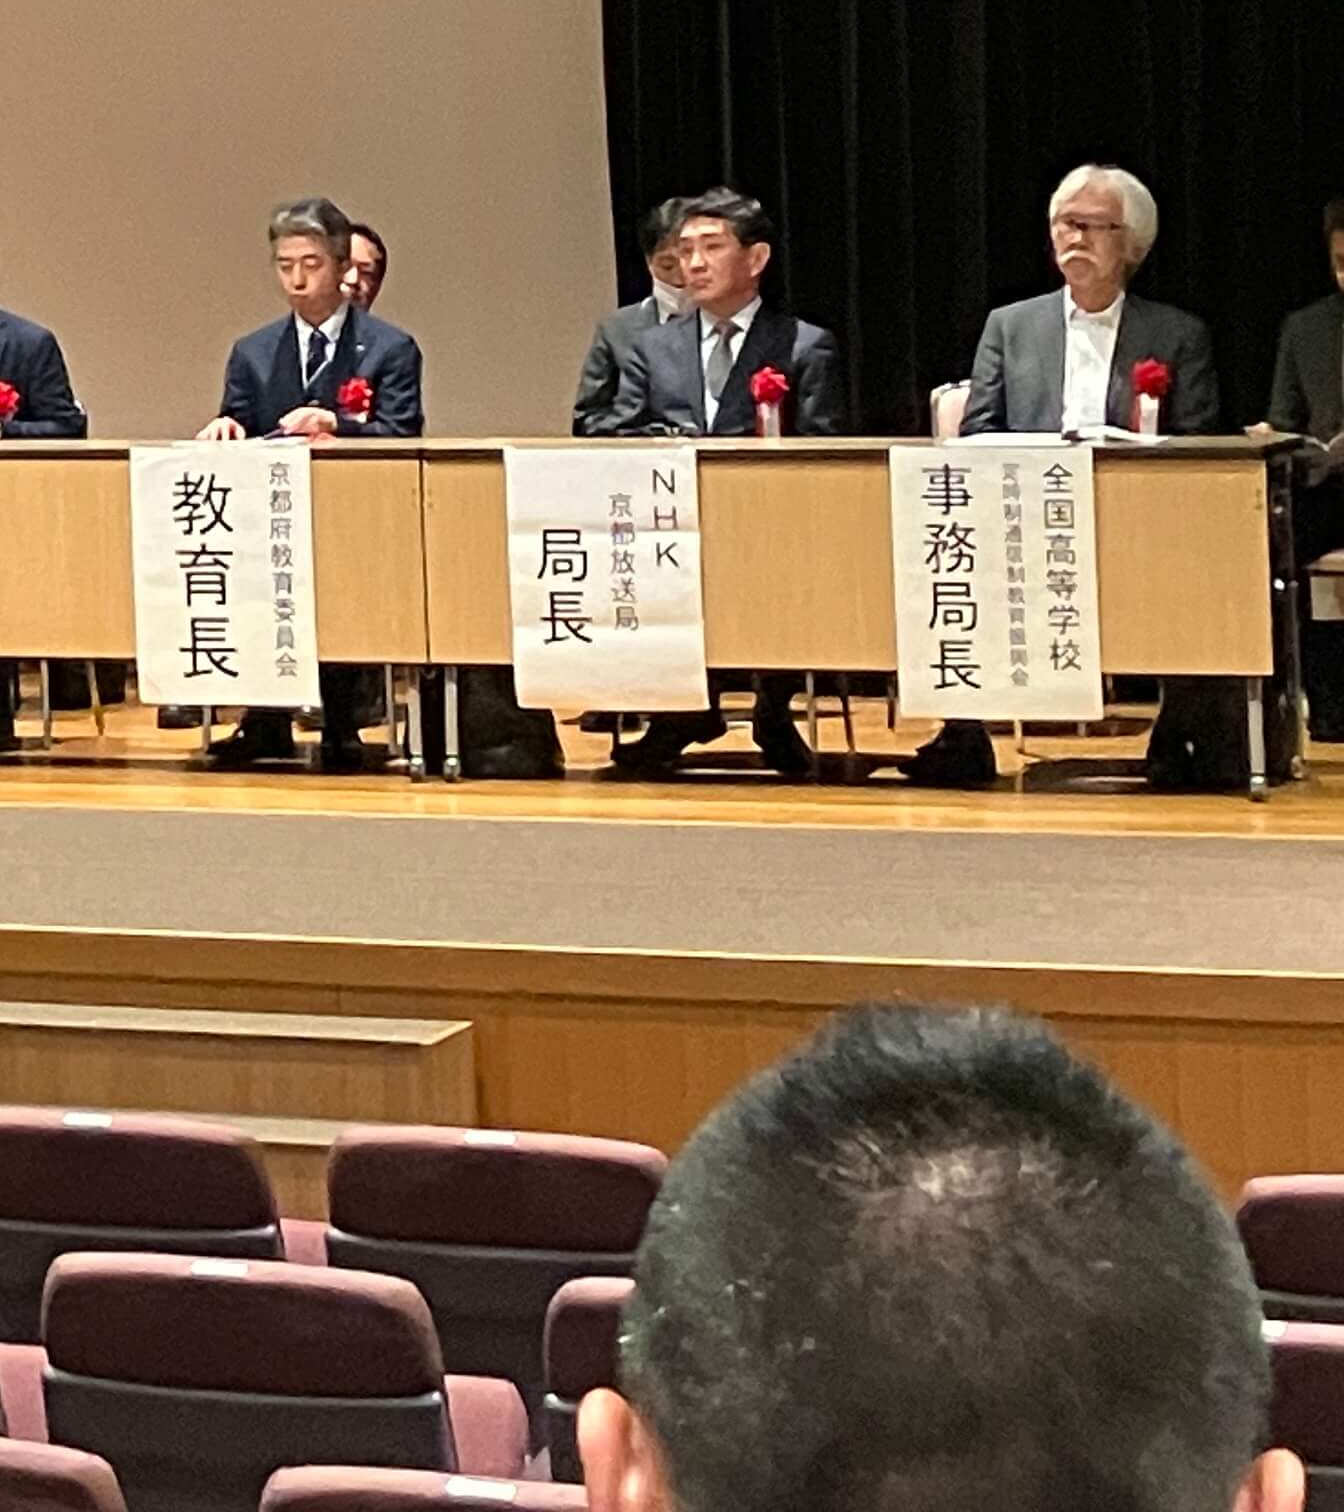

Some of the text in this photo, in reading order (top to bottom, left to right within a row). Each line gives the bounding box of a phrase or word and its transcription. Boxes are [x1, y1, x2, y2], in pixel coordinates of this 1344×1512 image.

[172, 472, 239, 679] 教育長
[268, 461, 298, 678] 京都府教育委員会
[537, 528, 593, 645] 局長
[609, 492, 640, 632] 京都放送局
[651, 468, 680, 568] NHK
[921, 463, 982, 690] 事務局長
[1043, 463, 1082, 671] 全国高等学校
